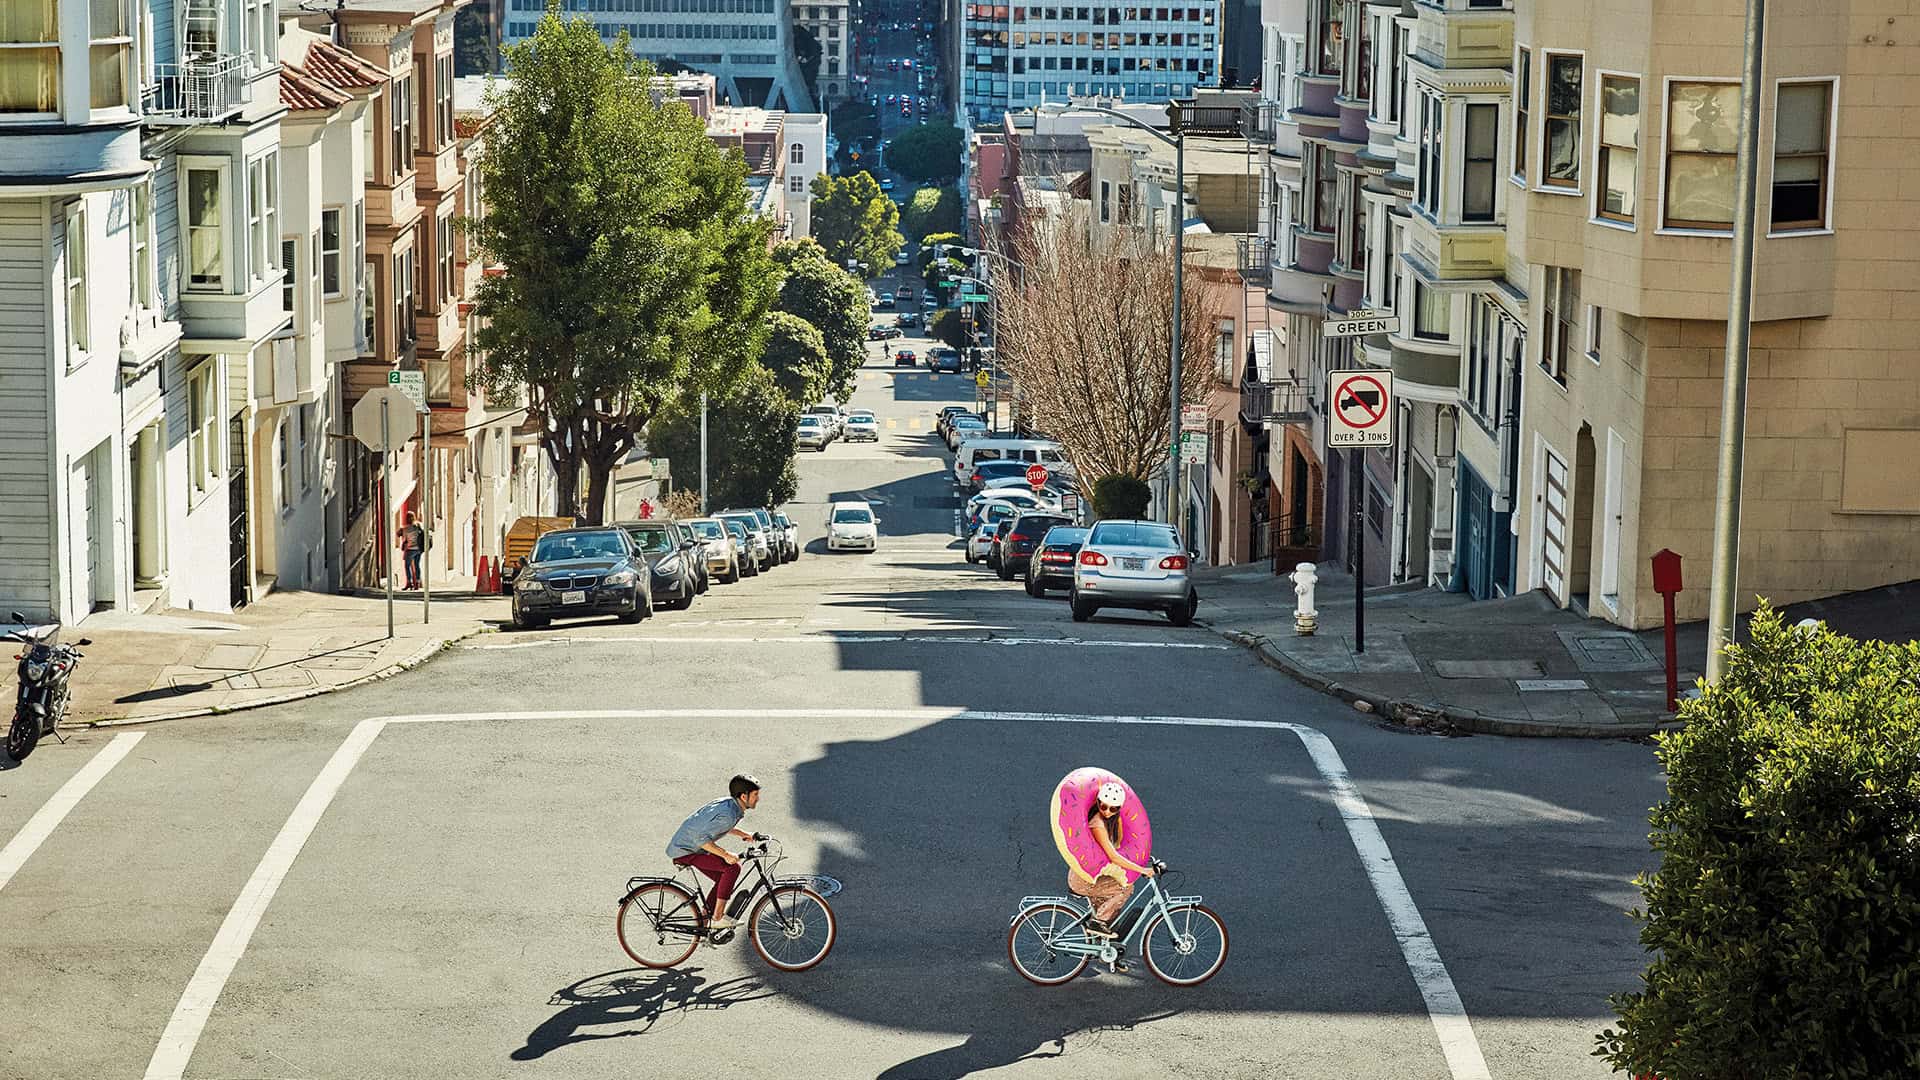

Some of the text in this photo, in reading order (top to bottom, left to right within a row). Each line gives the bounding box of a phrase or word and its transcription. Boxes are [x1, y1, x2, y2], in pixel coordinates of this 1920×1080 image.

[1337, 320, 1386, 333] GREEN
[391, 372, 399, 382] 2
[1334, 430, 1388, 442] OVER 3 TONS
[1027, 470, 1047, 480] STOP
